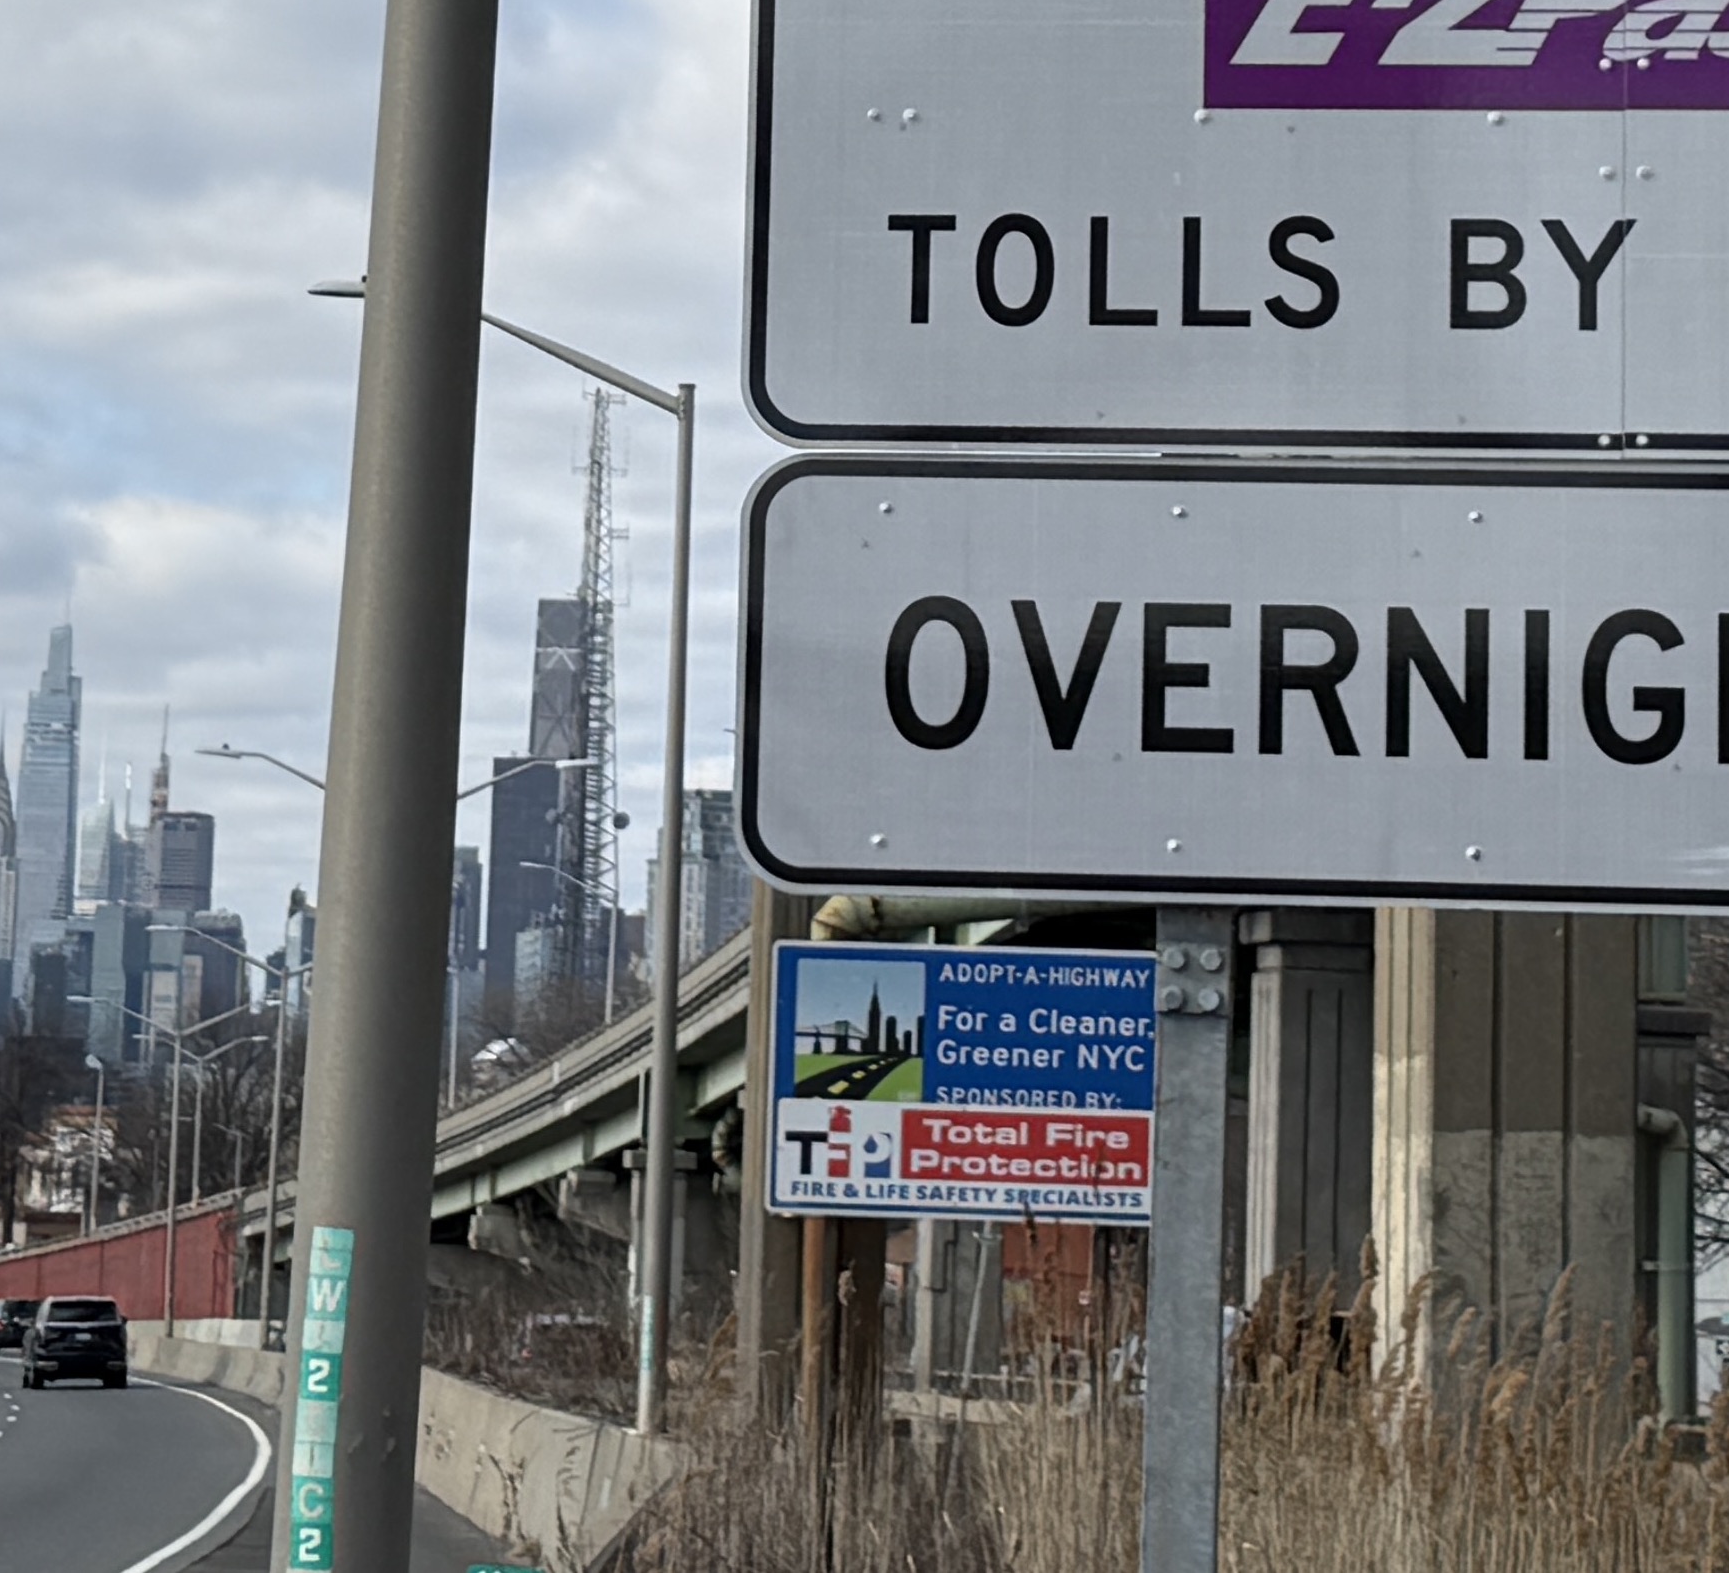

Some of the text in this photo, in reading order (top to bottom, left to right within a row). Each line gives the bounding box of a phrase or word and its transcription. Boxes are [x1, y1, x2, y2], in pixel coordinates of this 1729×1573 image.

[888, 214, 1339, 329] TOLLS
[1450, 219, 1636, 330] BY
[939, 962, 1151, 988] ADOPT-A-HIGHWAY
[937, 1005, 1155, 1039] For a Cleaner,
[937, 1039, 1146, 1071] Greener NYC
[936, 1086, 1078, 1109] SPONSORED
[1085, 1092, 1123, 1110] BY:
[922, 1117, 1131, 1150] Total Fire
[910, 1148, 1143, 1180] Protection
[791, 1180, 1144, 1208] FIRE & LIFE SAFETY SPECIALISTS
